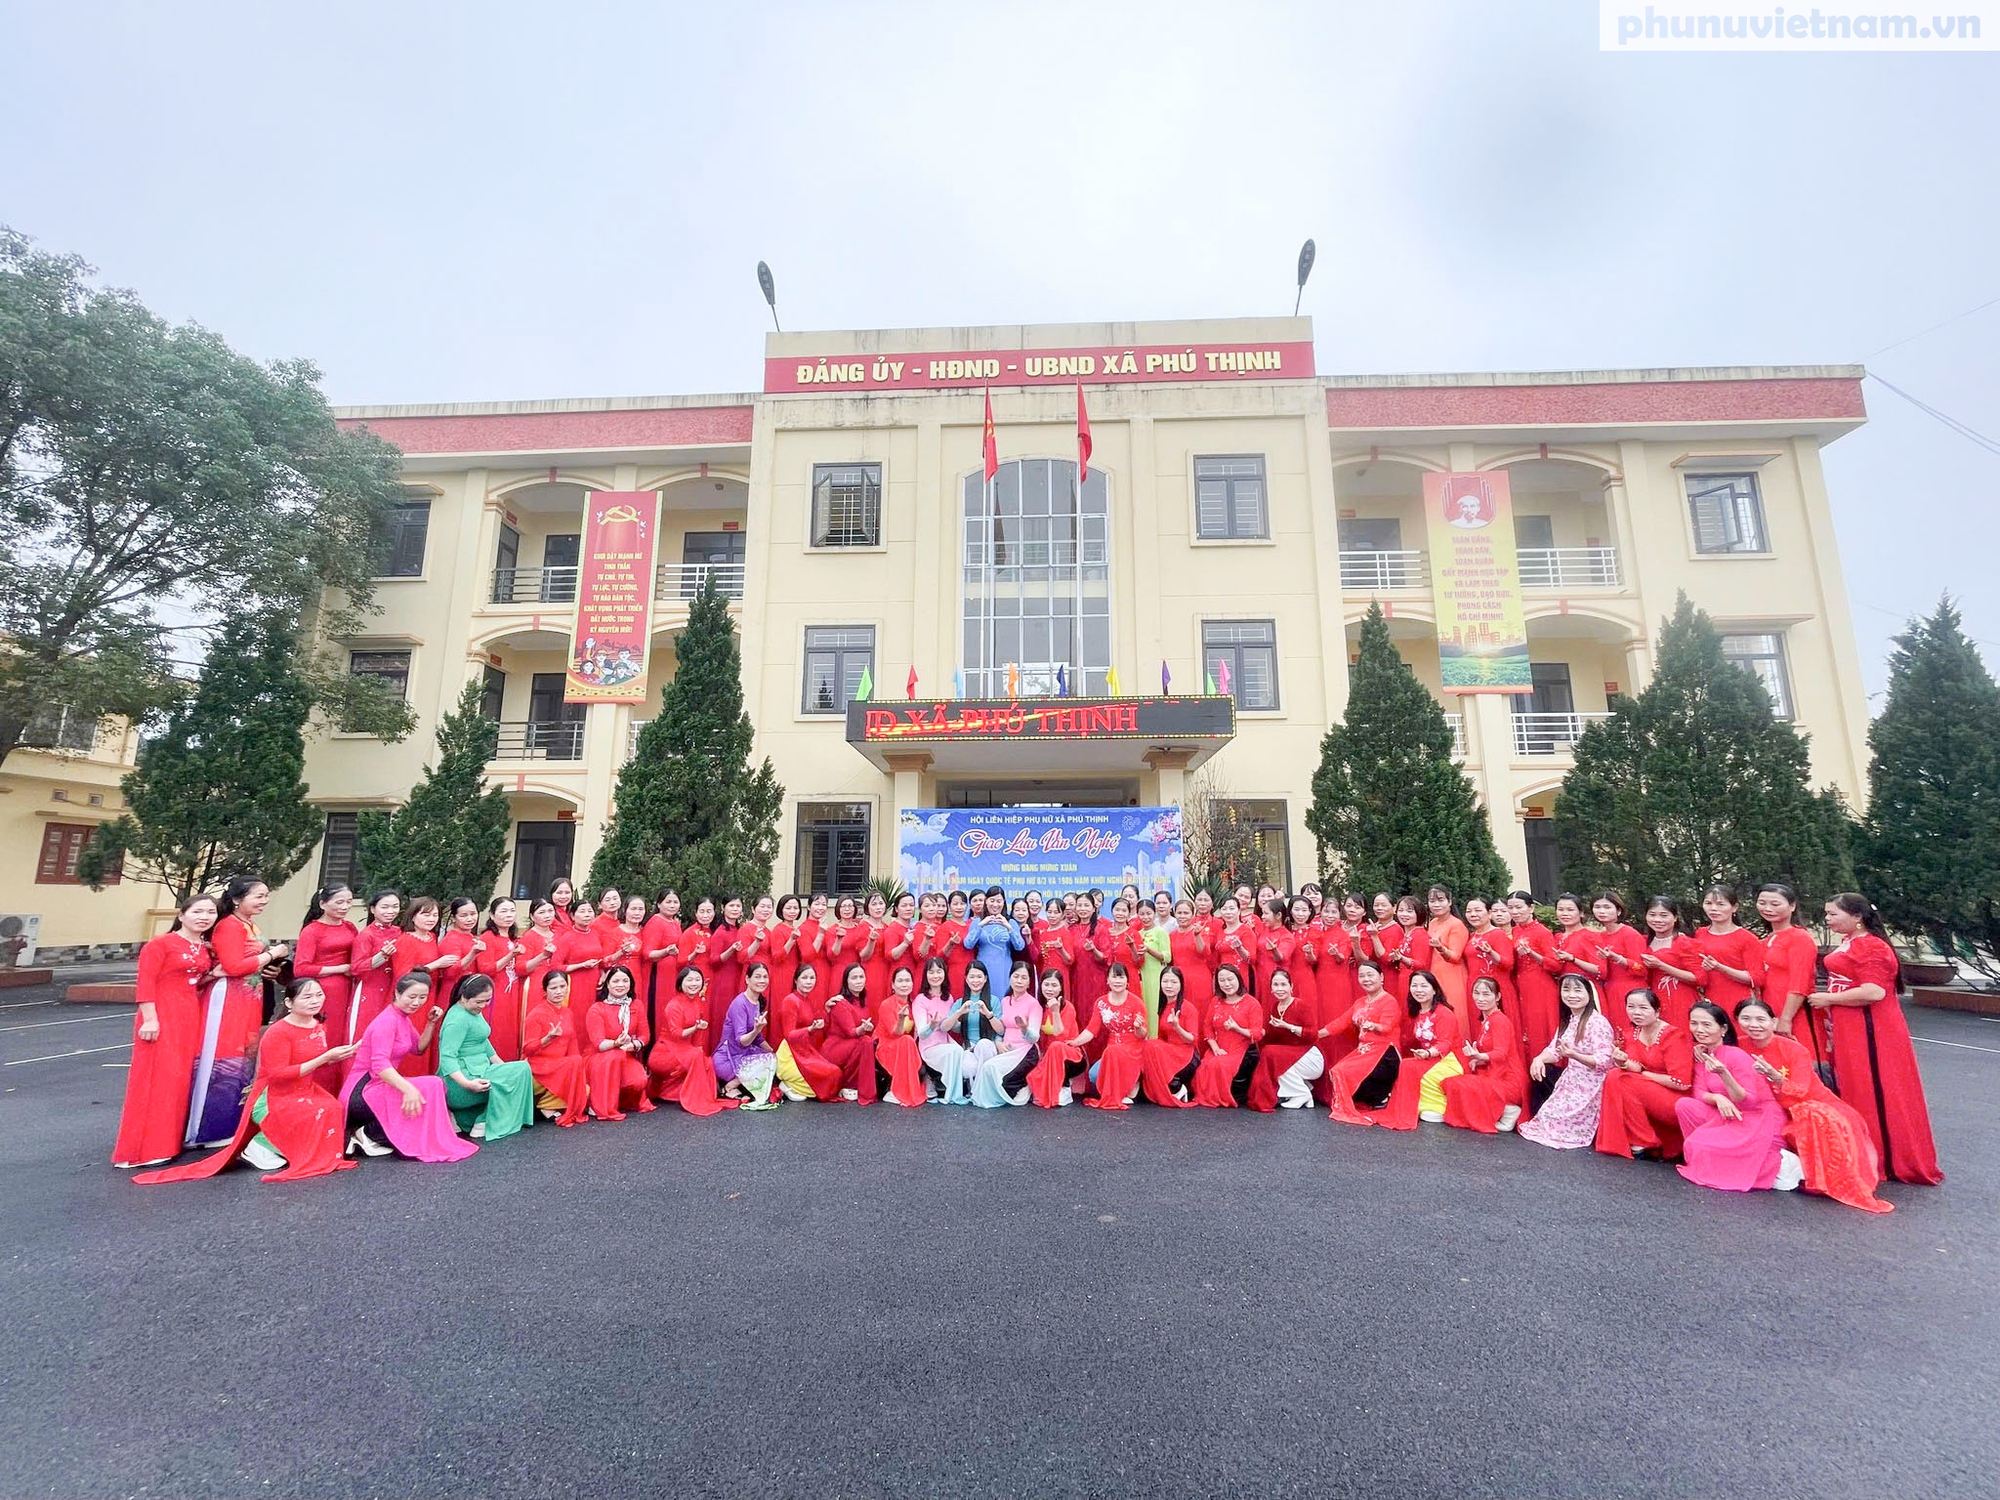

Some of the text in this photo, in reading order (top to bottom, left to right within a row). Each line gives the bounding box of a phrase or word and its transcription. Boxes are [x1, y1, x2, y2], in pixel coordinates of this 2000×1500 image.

[797, 358, 865, 383] ĐẢNG
[872, 356, 905, 381] ỦY
[929, 359, 1000, 380] HĐND
[1025, 356, 1095, 376] UBND
[1102, 350, 1139, 374] XÃ
[1146, 348, 1197, 373] PHÚ
[1204, 351, 1282, 375] THỊNH
[959, 702, 1027, 733] PHÚ
[1034, 706, 1139, 737] THỊNH
[970, 815, 984, 824] HỘI
[986, 815, 1003, 824] LIÊN
[1004, 815, 1023, 824] HIỆP
[1024, 815, 1041, 824] PHỤ
[1085, 815, 1109, 824] THỊNH
[958, 828, 1004, 858] Giao
[1003, 827, 1037, 856] Lưu
[1072, 827, 1121, 858] Nghệ
